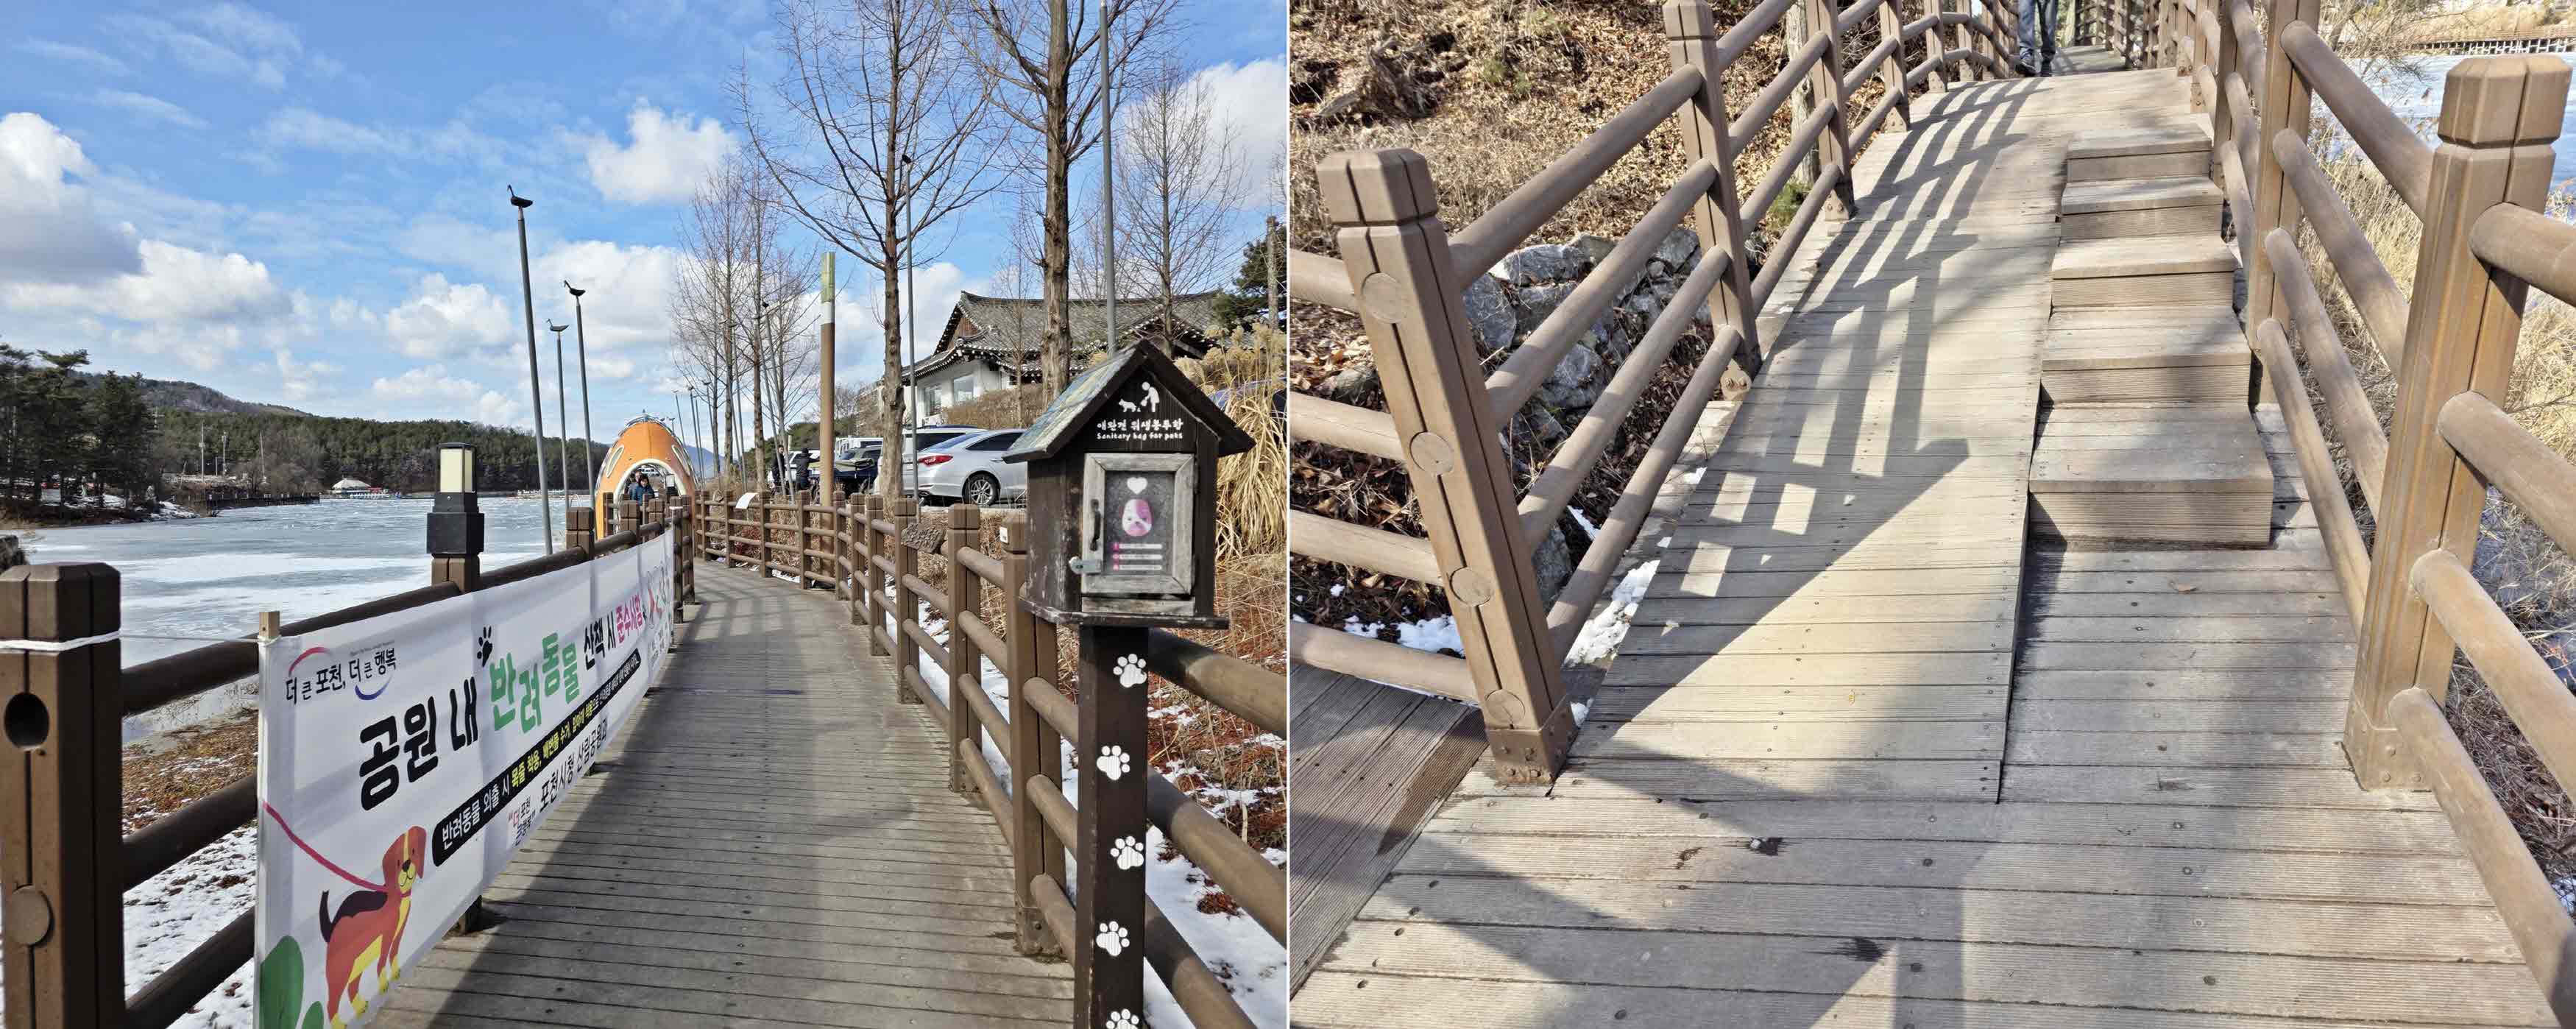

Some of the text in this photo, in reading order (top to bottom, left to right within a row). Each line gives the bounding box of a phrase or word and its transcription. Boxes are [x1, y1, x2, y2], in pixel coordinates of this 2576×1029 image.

[1097, 418, 1183, 431] 애완견 위생봉투함
[1097, 432, 1130, 441] Sanitary
[1133, 432, 1147, 441] bag
[1164, 432, 1183, 441] pets
[286, 676, 297, 705] 더
[301, 681, 312, 700] 큰
[316, 663, 346, 694] 포천,
[348, 658, 361, 682] 더
[364, 662, 373, 679] 큰
[374, 648, 396, 675] 행복
[359, 696, 439, 810] 공원
[450, 676, 478, 751] 내
[489, 632, 580, 733] 반려동물
[584, 618, 605, 671] 산책
[607, 611, 616, 650] 시
[539, 717, 608, 813] 포천시청 산림공원과
[442, 799, 481, 850] 반려동물
[483, 784, 500, 813] 외출
[502, 774, 510, 796] 시
[511, 761, 526, 788] 목줄
